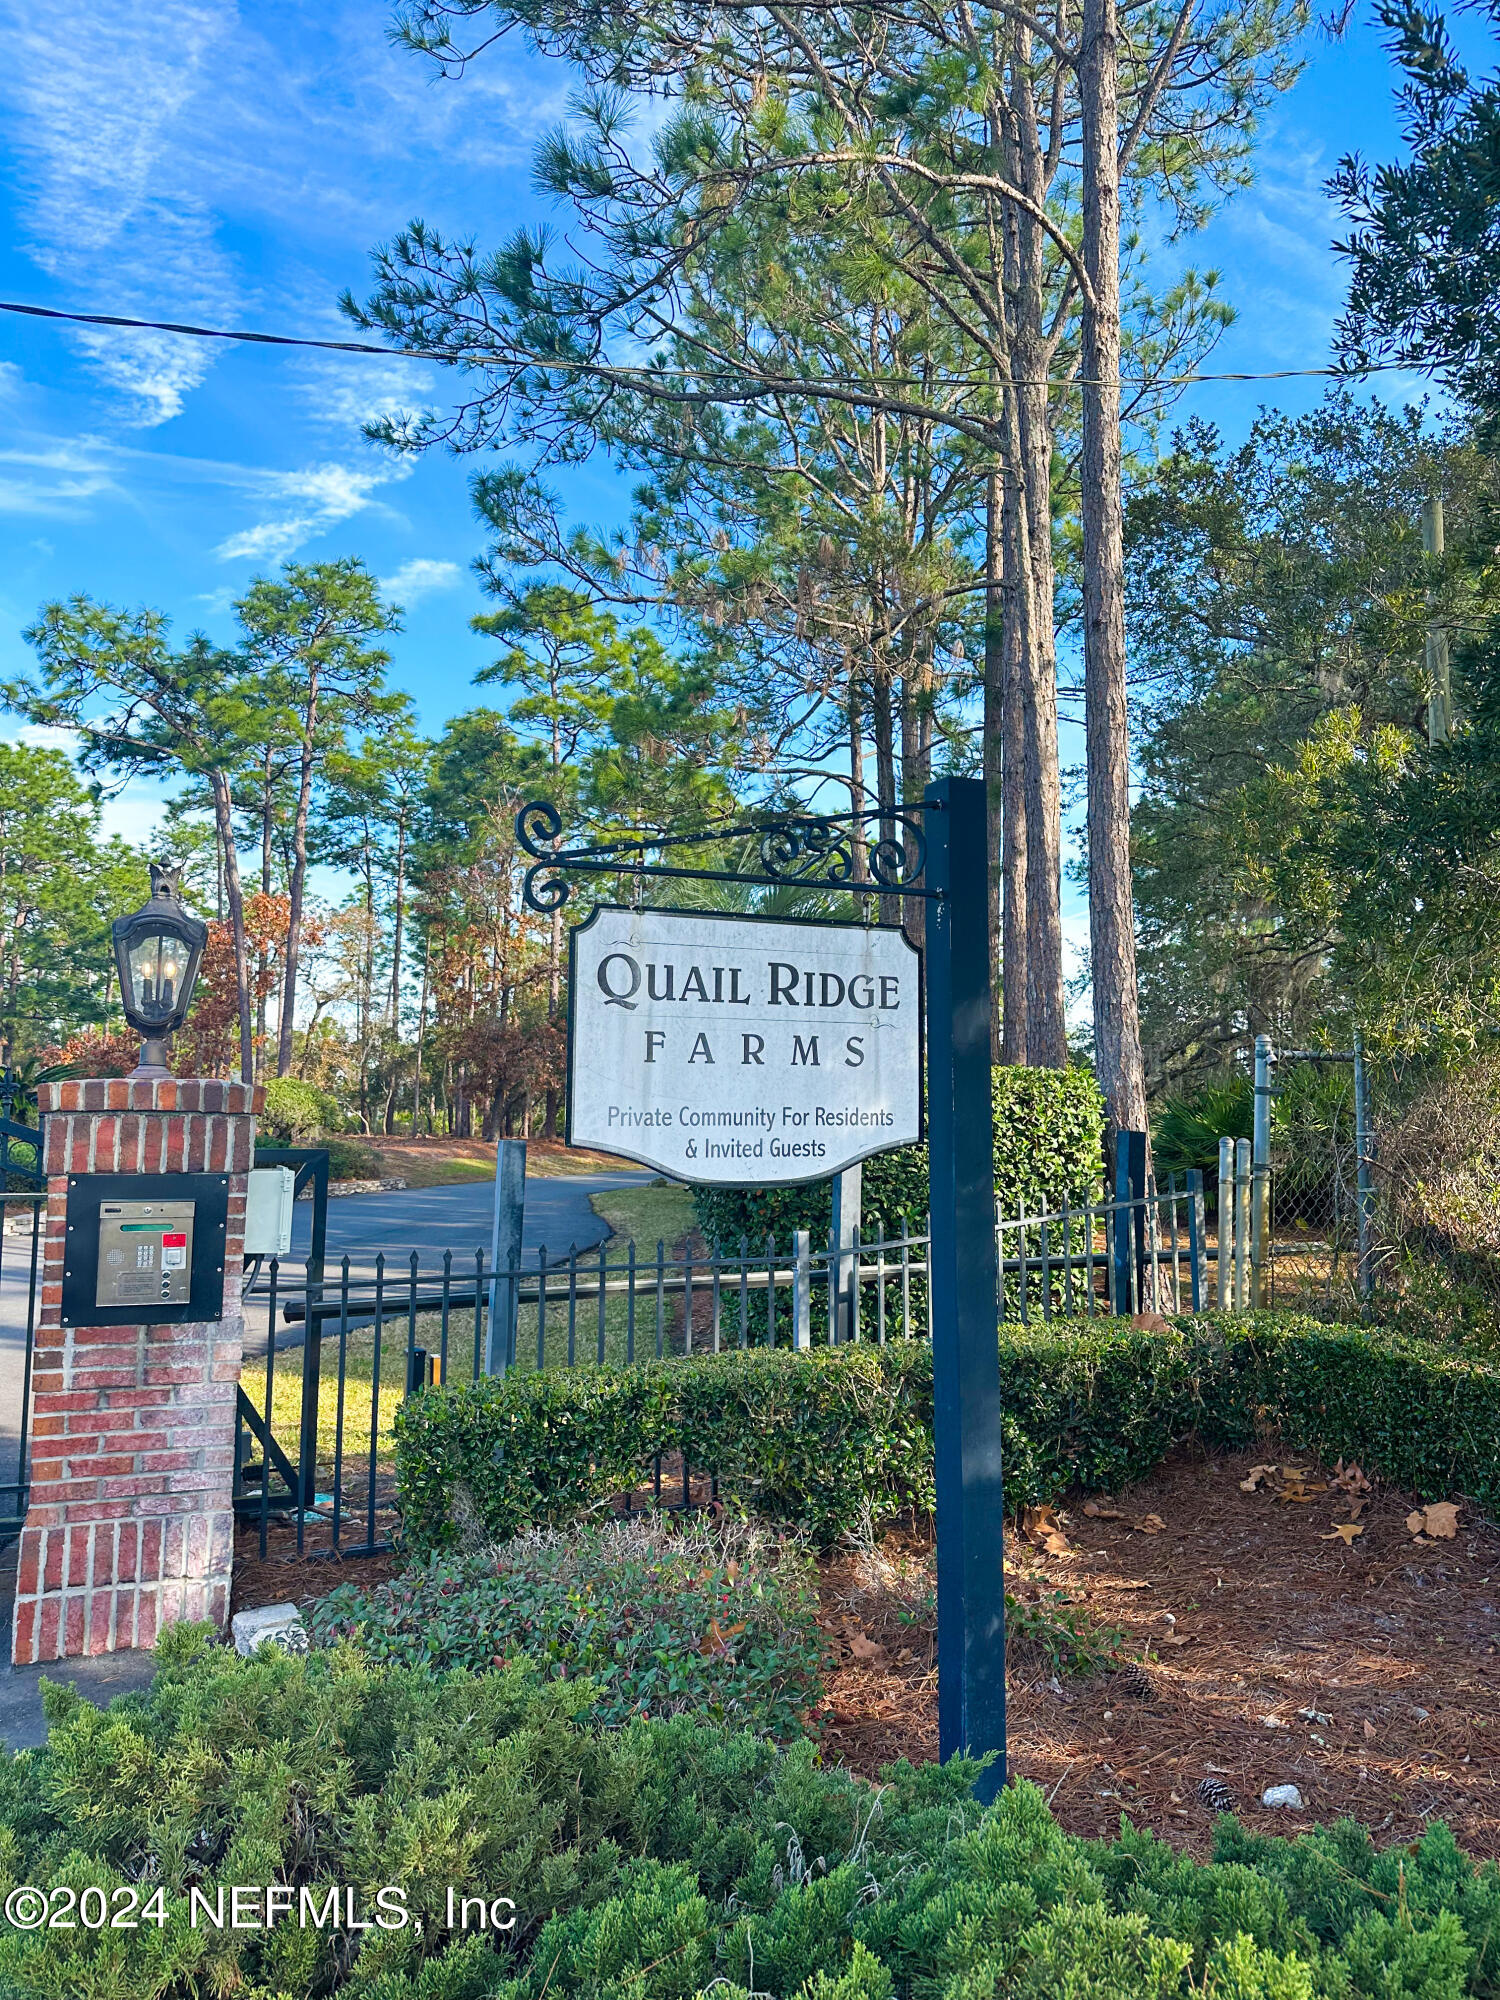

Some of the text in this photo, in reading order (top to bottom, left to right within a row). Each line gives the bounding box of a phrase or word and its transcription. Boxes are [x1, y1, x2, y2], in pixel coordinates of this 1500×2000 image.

[597, 953, 900, 1010] QUAIL RIDGE
[644, 1030, 865, 1067] FARMS
[607, 1105, 894, 1132] Private Community For Residents
[685, 1138, 826, 1158] & Invited Guests
